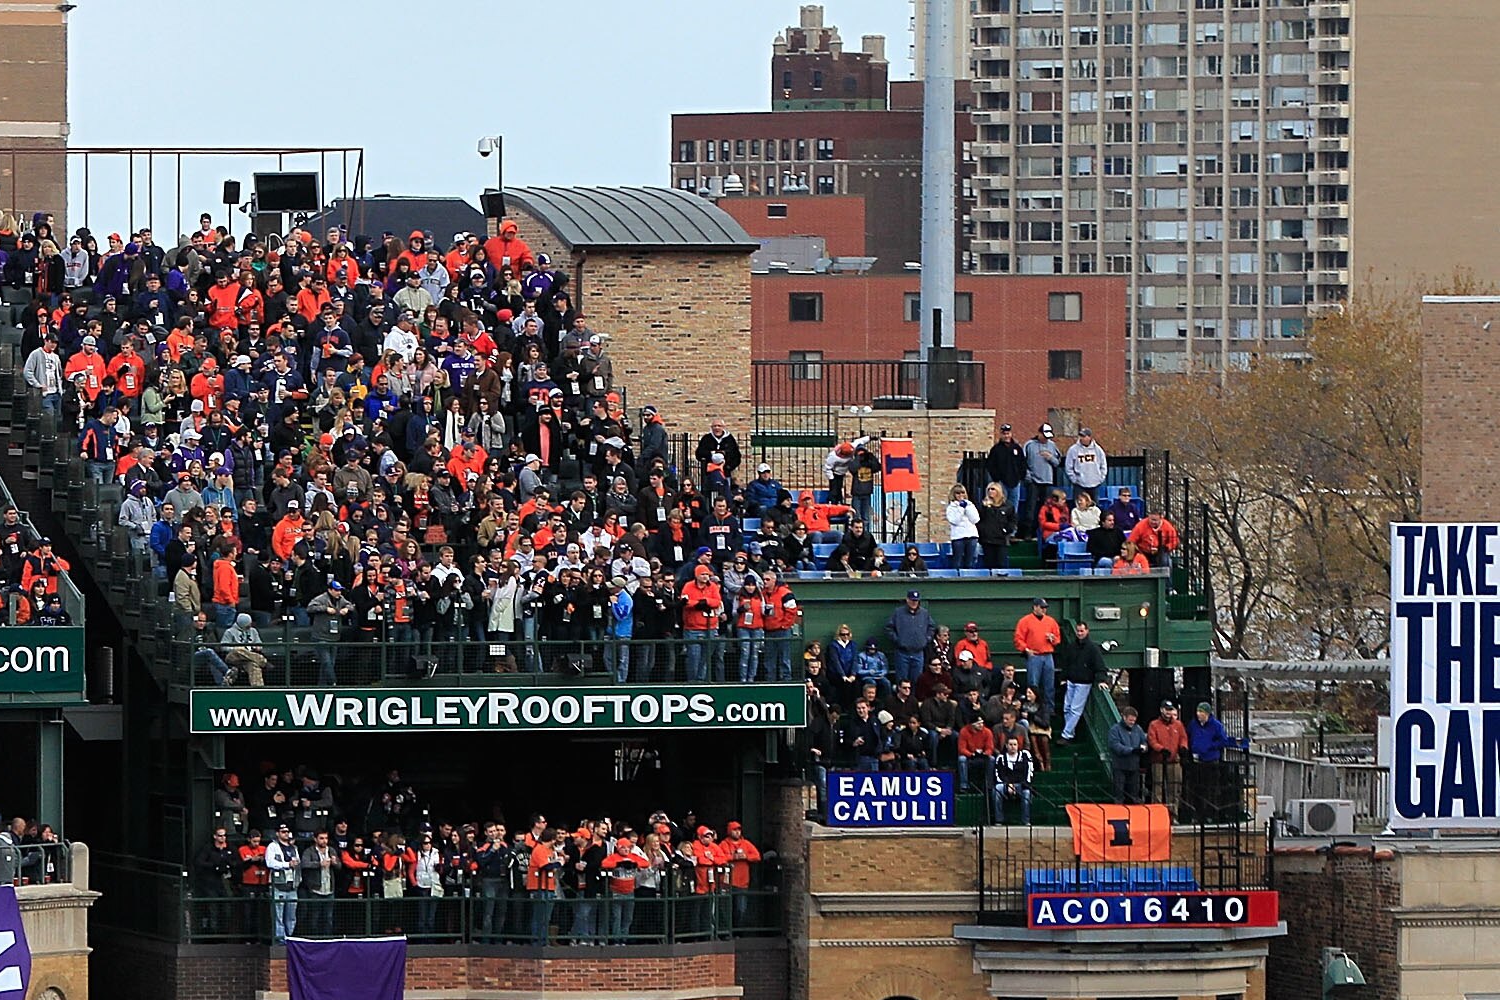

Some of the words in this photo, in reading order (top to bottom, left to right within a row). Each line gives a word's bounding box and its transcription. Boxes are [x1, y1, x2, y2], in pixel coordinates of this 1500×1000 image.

[1397, 525, 1497, 596] TAKE
[1397, 602, 1500, 704] THE
[209, 692, 786, 728] www.WRIGLEYROOFTOPS.com
[839, 776, 943, 797] EAMUS
[833, 800, 949, 822] CATULI!
